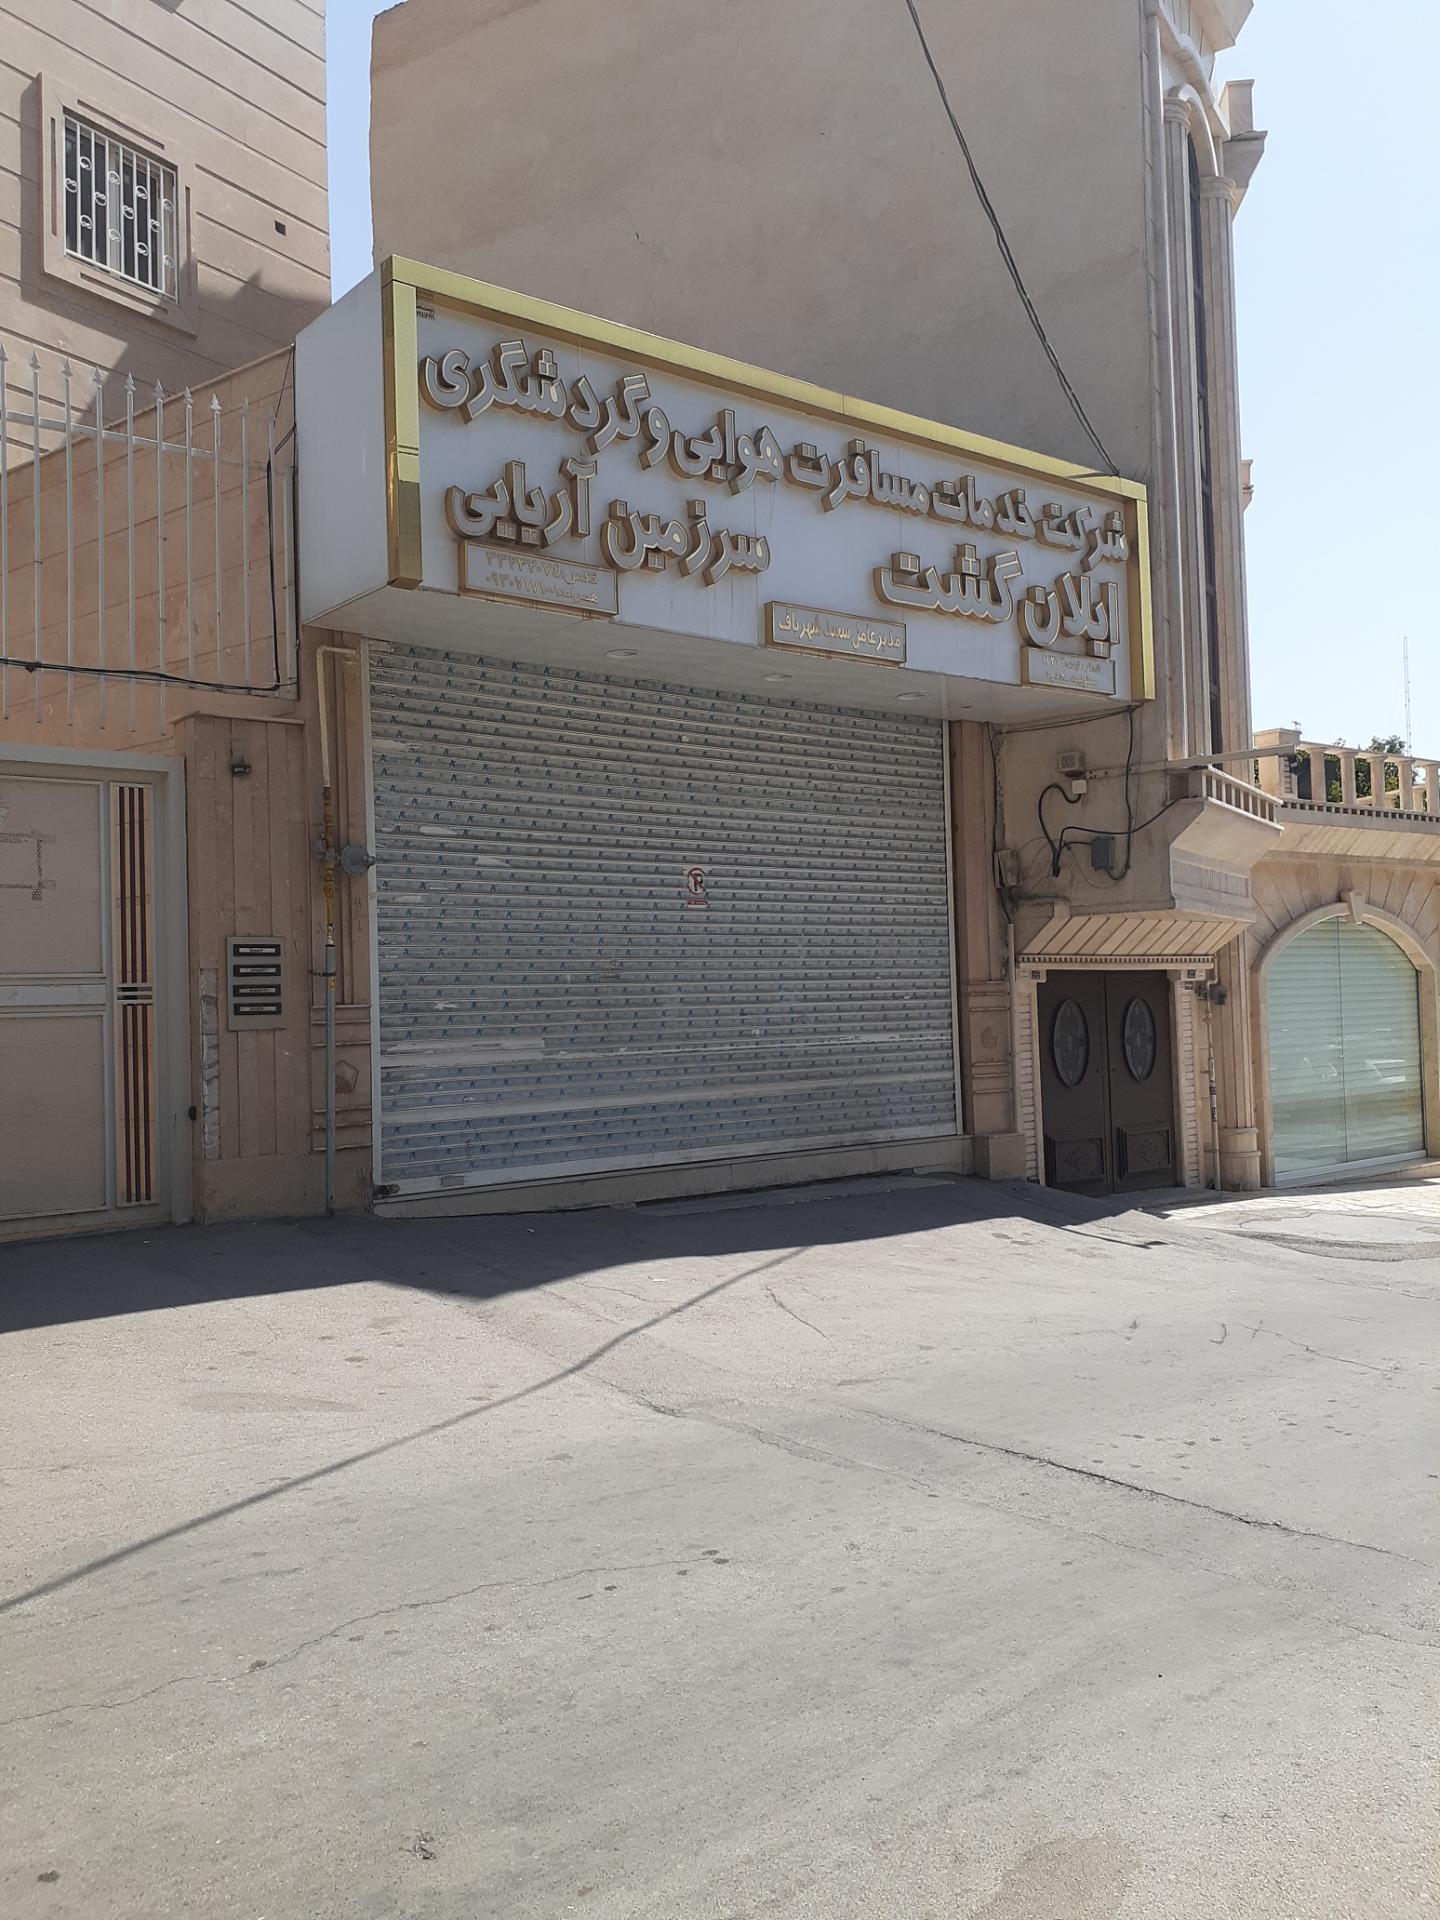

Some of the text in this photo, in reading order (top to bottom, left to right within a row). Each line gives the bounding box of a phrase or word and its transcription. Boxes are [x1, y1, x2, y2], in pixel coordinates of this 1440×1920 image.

[668, 408, 785, 496] هوایی
[784, 438, 930, 514] مسافرت
[446, 457, 598, 549] آریایی
[600, 499, 771, 587] سرزمین
[929, 474, 1037, 541] خدمات
[1034, 502, 1129, 572] شرکت
[873, 542, 1024, 625] گشت
